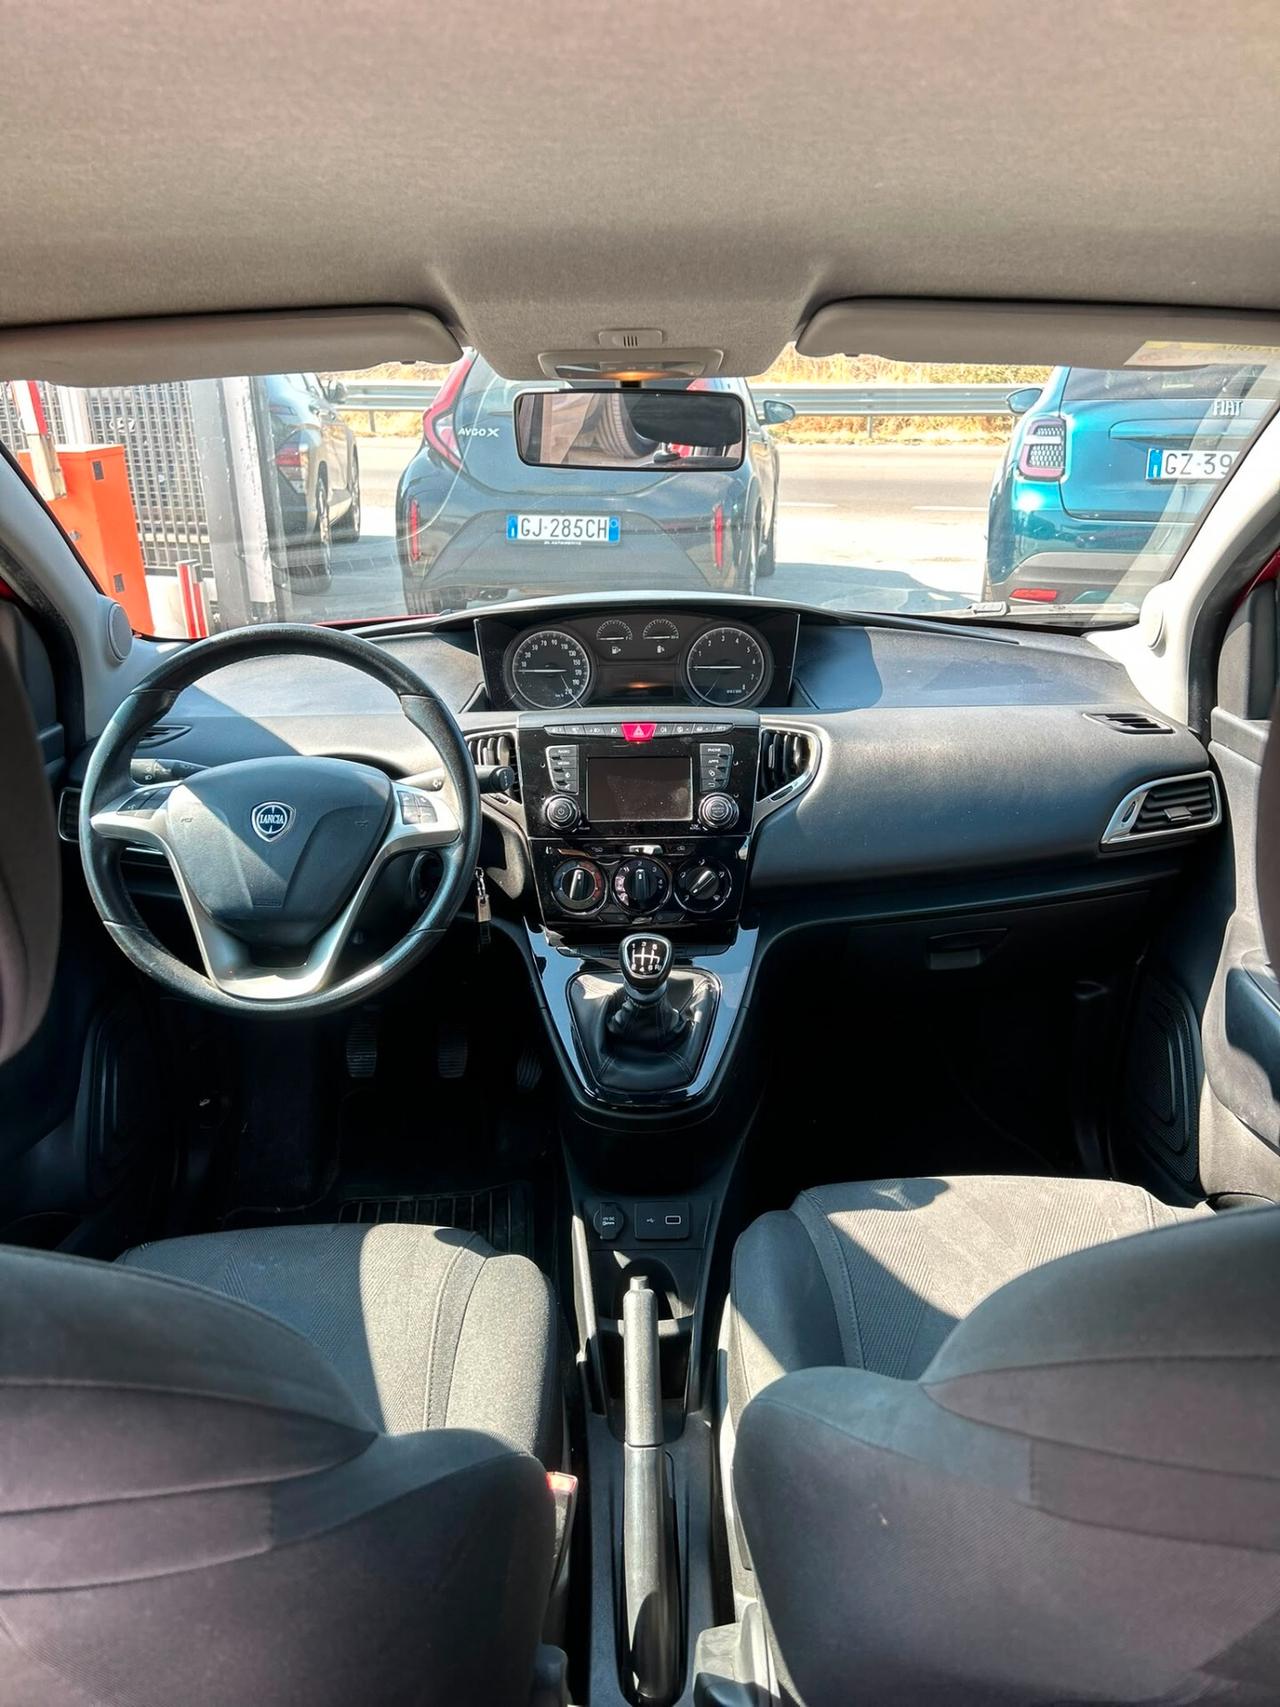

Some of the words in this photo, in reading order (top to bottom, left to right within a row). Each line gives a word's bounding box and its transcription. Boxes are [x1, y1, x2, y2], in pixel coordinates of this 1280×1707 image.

[1212, 400, 1243, 416] FIAT
[458, 427, 486, 436] AYGO
[486, 427, 500, 437] X
[260, 814, 284, 824] LANCIA
